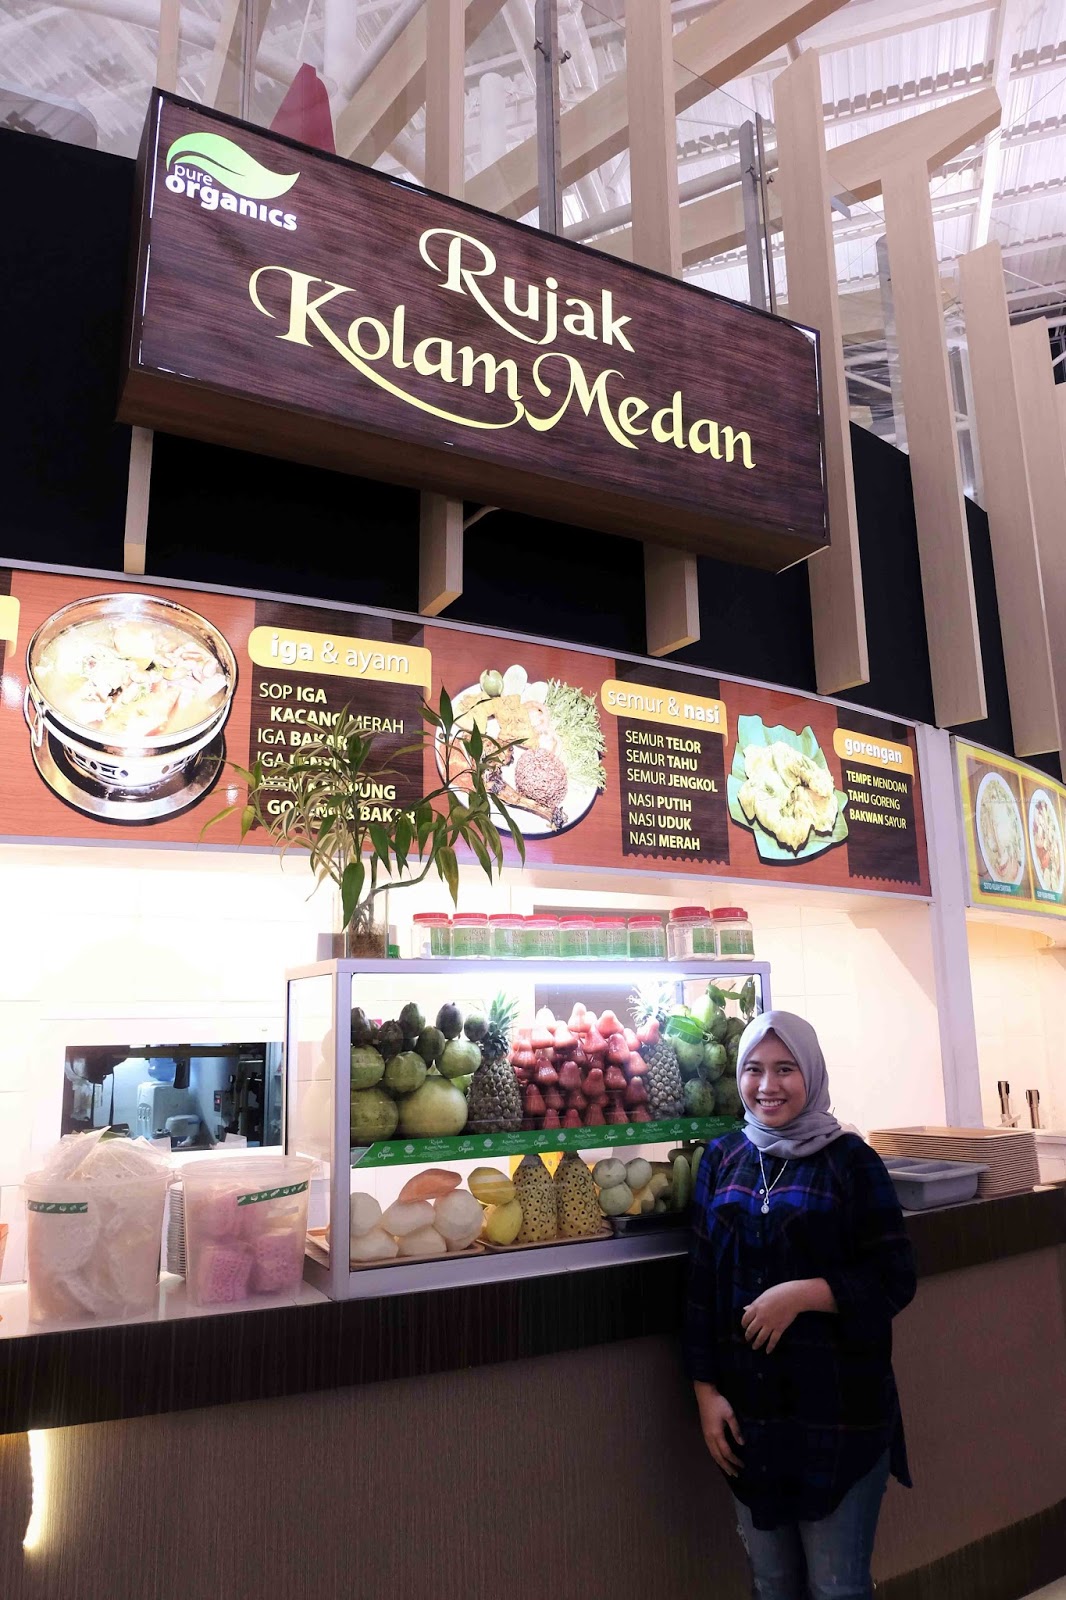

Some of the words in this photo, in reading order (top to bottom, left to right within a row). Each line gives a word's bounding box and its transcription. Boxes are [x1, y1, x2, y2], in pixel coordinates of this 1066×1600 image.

[174, 164, 213, 186] pure
[165, 174, 298, 231] organics
[418, 227, 635, 353] Rujak
[249, 264, 525, 429] Kolam
[524, 352, 757, 470] Medan
[271, 633, 314, 665] iga
[320, 640, 339, 664] &
[345, 649, 410, 674] ayam
[259, 682, 293, 700] SOP
[297, 686, 328, 705] IGA
[607, 689, 664, 714] semur
[667, 696, 681, 718] &
[683, 703, 720, 725] nasi
[257, 727, 287, 746] IGA
[625, 729, 665, 748] SEMUR
[666, 736, 702, 755] TELOR
[257, 750, 285, 768] IGA
[626, 748, 666, 767] SEMUR
[667, 755, 698, 772] TAHU
[844, 737, 903, 765] gorengan
[627, 767, 666, 786] SEMUR
[668, 774, 718, 793] JENGKOL
[846, 770, 873, 786] TEMPE
[873, 776, 908, 794] MENDOAN
[628, 792, 655, 808] NASI
[657, 796, 692, 812] PUTIH
[847, 789, 870, 804] TAHU
[870, 793, 901, 811] GORENG
[629, 811, 656, 827] NASI
[658, 815, 692, 831] UDUK
[849, 808, 884, 825] BAKWAN
[884, 815, 907, 830] SAYUR
[630, 831, 656, 847] NASI
[659, 835, 700, 851] MERAH
